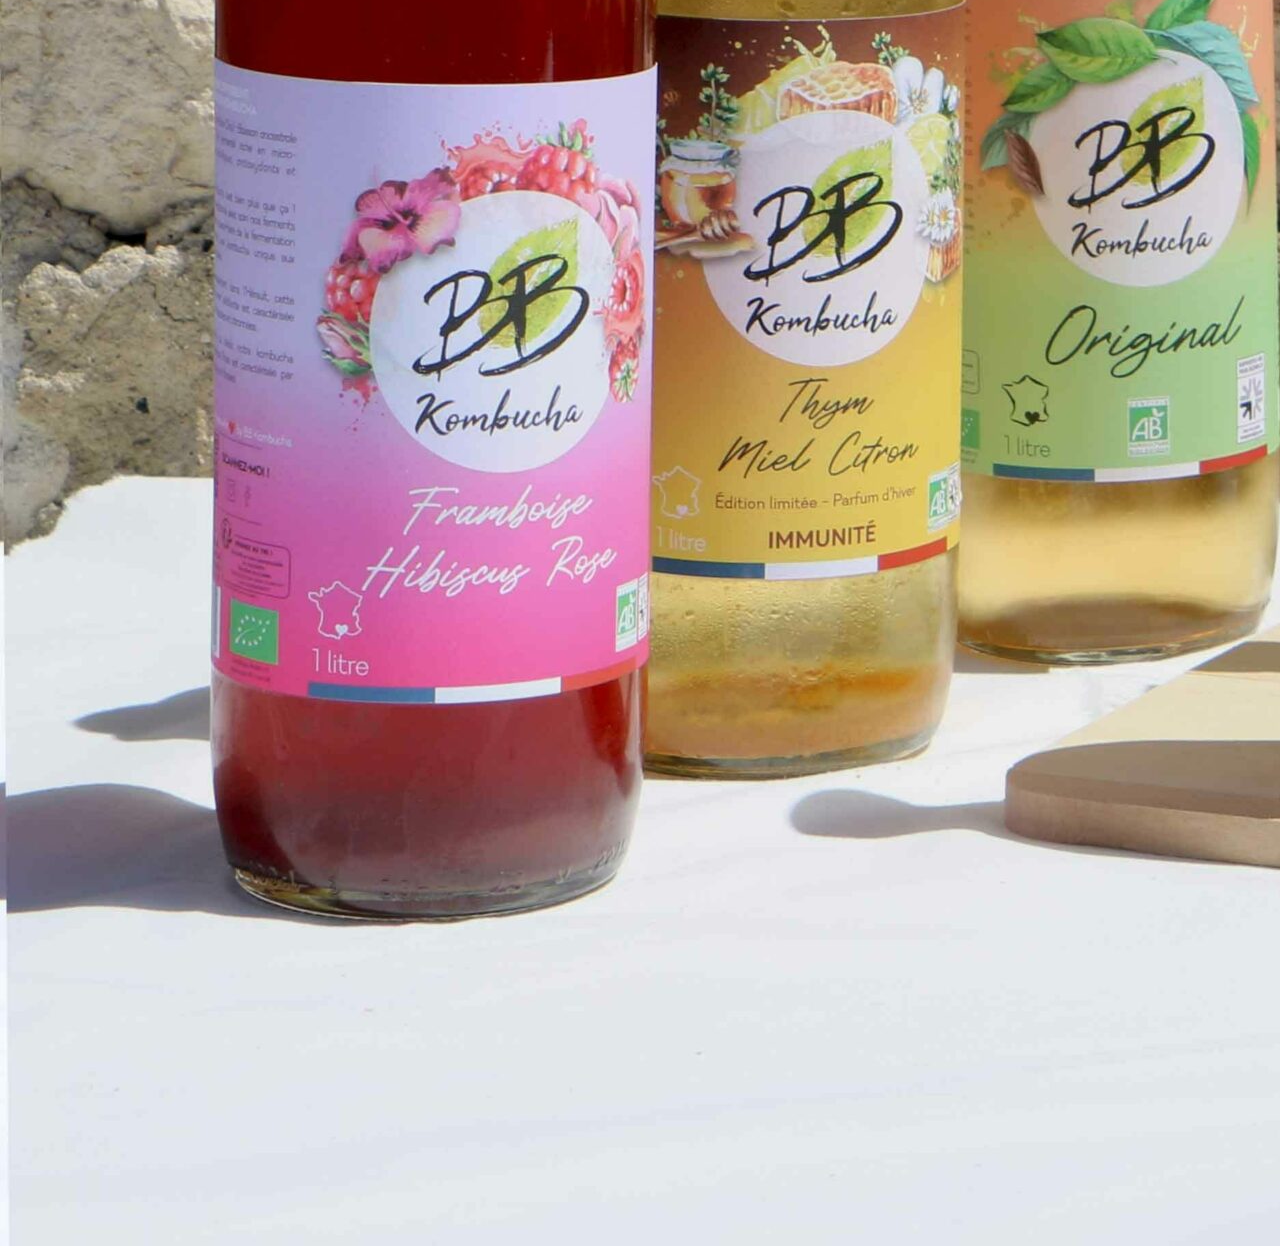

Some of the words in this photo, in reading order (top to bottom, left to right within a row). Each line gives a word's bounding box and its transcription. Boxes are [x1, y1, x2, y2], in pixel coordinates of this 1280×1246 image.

[1067, 106, 1216, 213] BB
[743, 171, 903, 286] BB
[1070, 216, 1214, 258] Kombucha
[412, 254, 590, 381] BB
[745, 291, 899, 337] Kombucha
[1045, 294, 1246, 378] Original
[415, 385, 584, 436] Kombucha
[780, 377, 875, 429] Thym
[1004, 435, 1010, 454] 1
[1017, 436, 1051, 458] litre
[1132, 416, 1162, 441] AB
[717, 435, 811, 479] Miel
[827, 430, 920, 477] Citron
[403, 485, 593, 535] Framboise
[715, 492, 766, 511] Édition
[769, 494, 817, 510] limitée
[833, 492, 878, 509] Parfum
[881, 484, 917, 504] d'hiver
[669, 527, 707, 553] litre
[768, 520, 877, 549] IMMUNITÉ
[362, 547, 530, 599] Hibiscus
[546, 536, 617, 587] Rose
[312, 648, 319, 672] 1
[328, 651, 369, 676] litre
